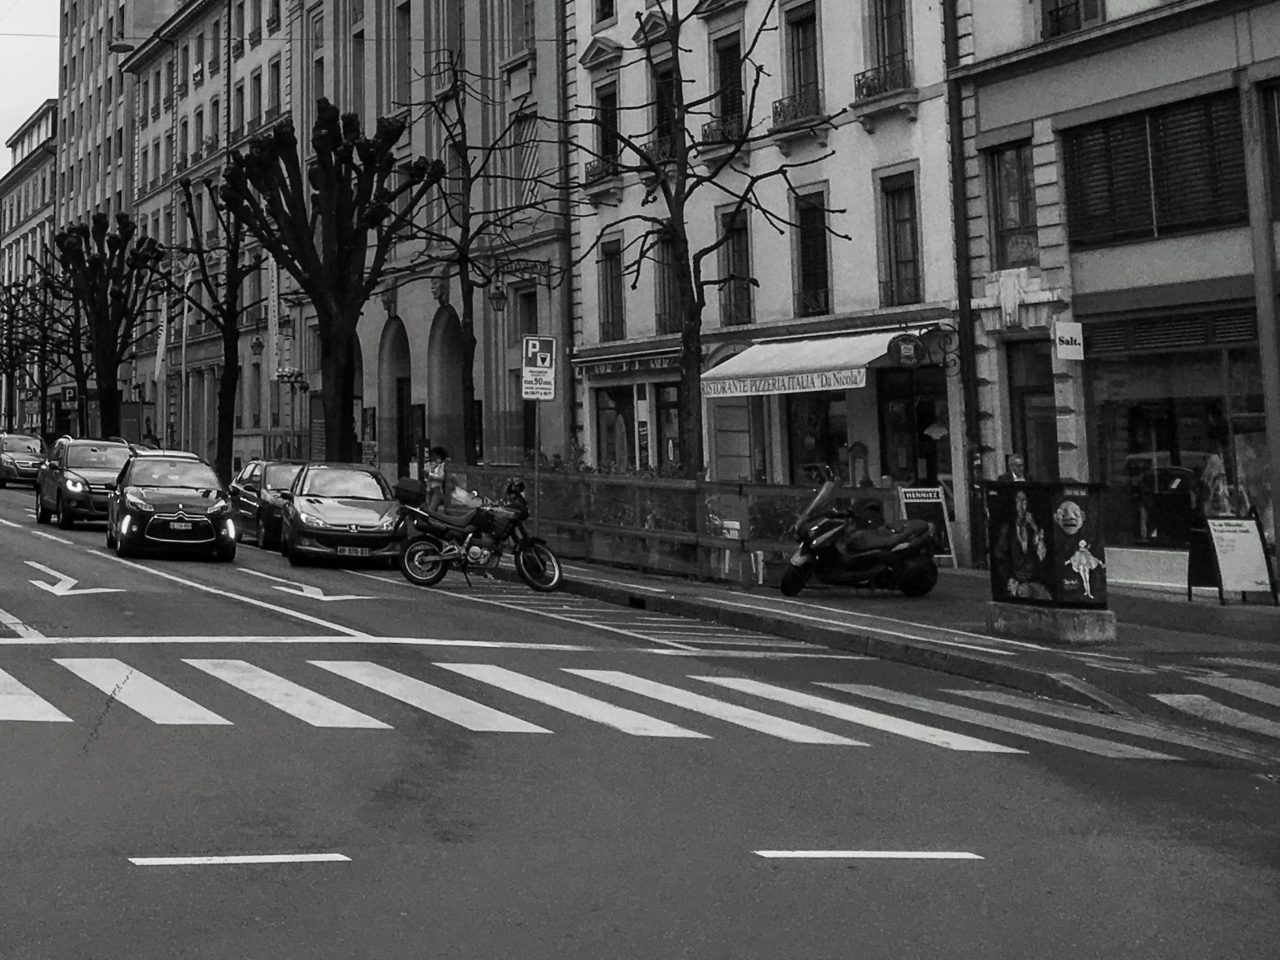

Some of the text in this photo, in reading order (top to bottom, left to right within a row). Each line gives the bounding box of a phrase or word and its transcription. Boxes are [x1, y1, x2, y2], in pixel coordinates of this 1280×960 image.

[528, 340, 540, 358] P
[750, 376, 787, 392] PIZZERIA
[787, 374, 816, 390] ITALIA
[65, 389, 74, 401] P
